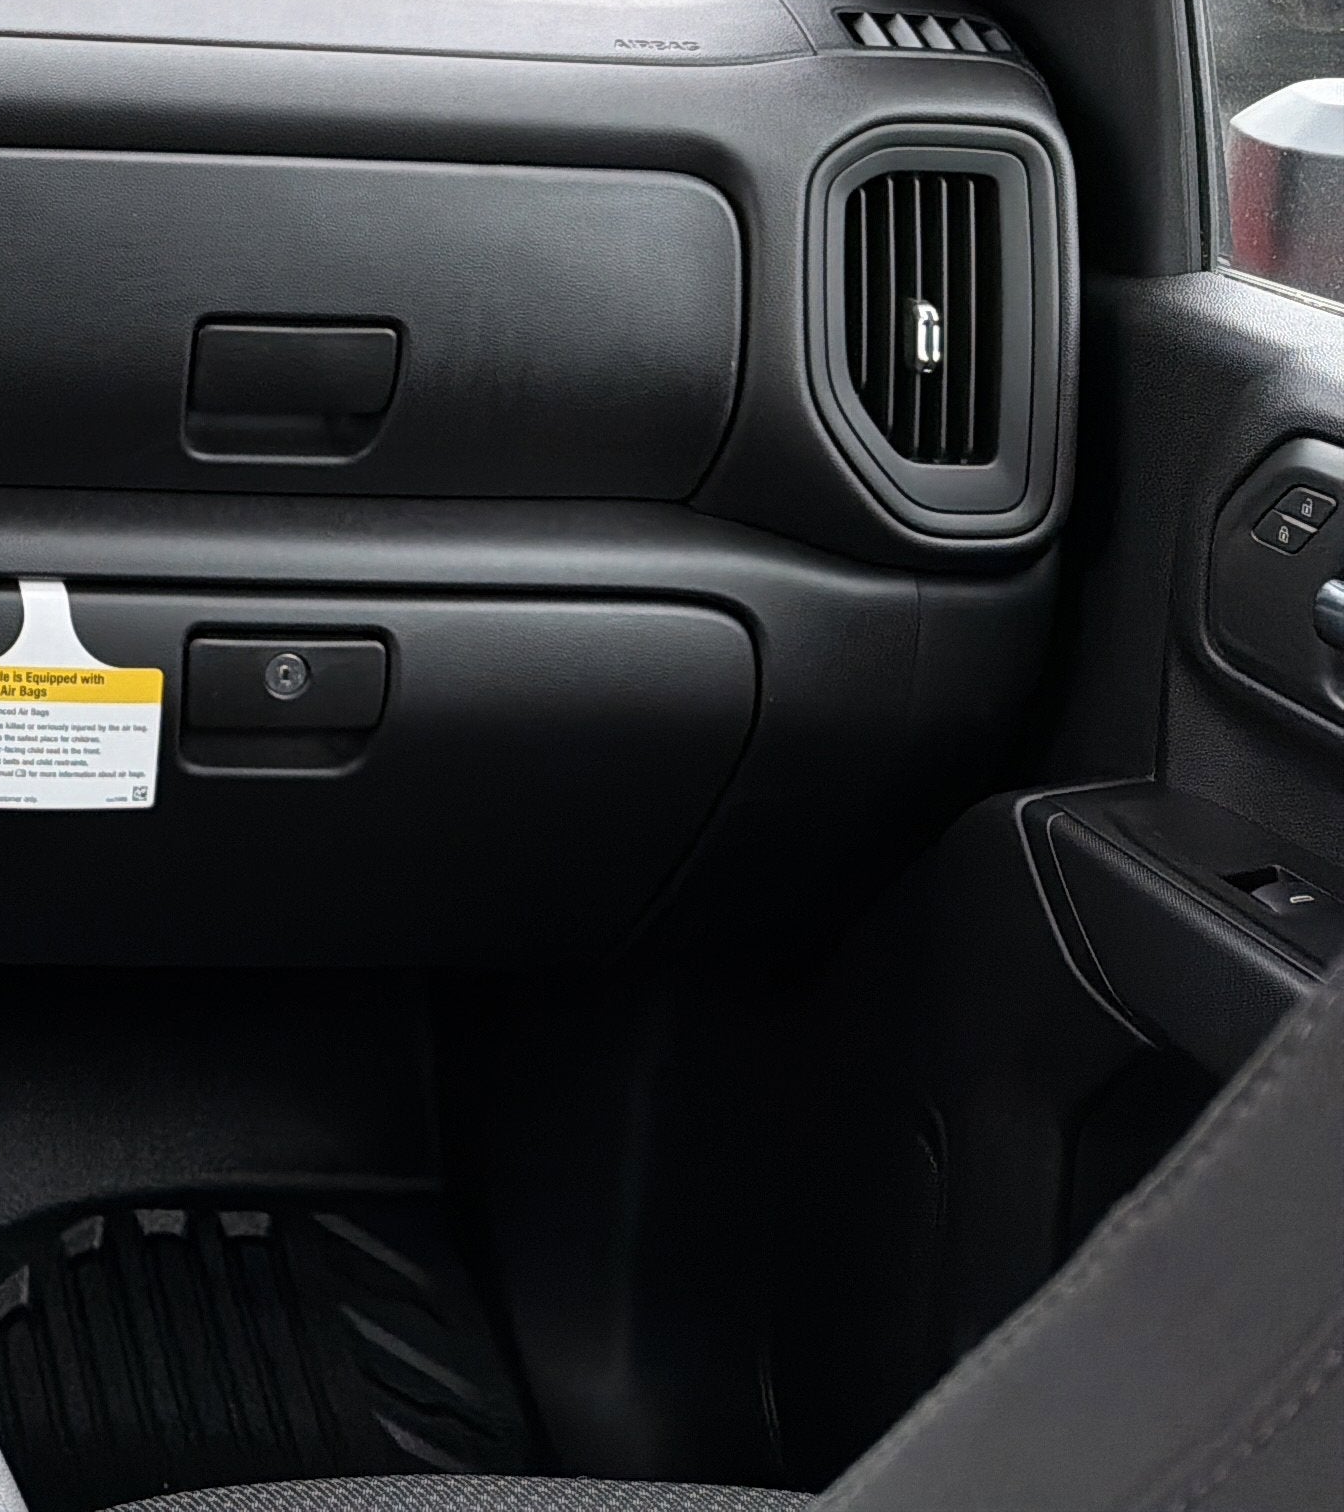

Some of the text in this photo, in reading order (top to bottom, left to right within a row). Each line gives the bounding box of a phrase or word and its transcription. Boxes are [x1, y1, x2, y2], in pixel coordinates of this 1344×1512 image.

[13, 672, 23, 682] is
[26, 673, 77, 685] Equipped
[81, 673, 105, 685] with
[0, 685, 15, 696] Air
[20, 686, 47, 699] Bags
[18, 707, 28, 716] Air
[31, 708, 49, 717] Bags
